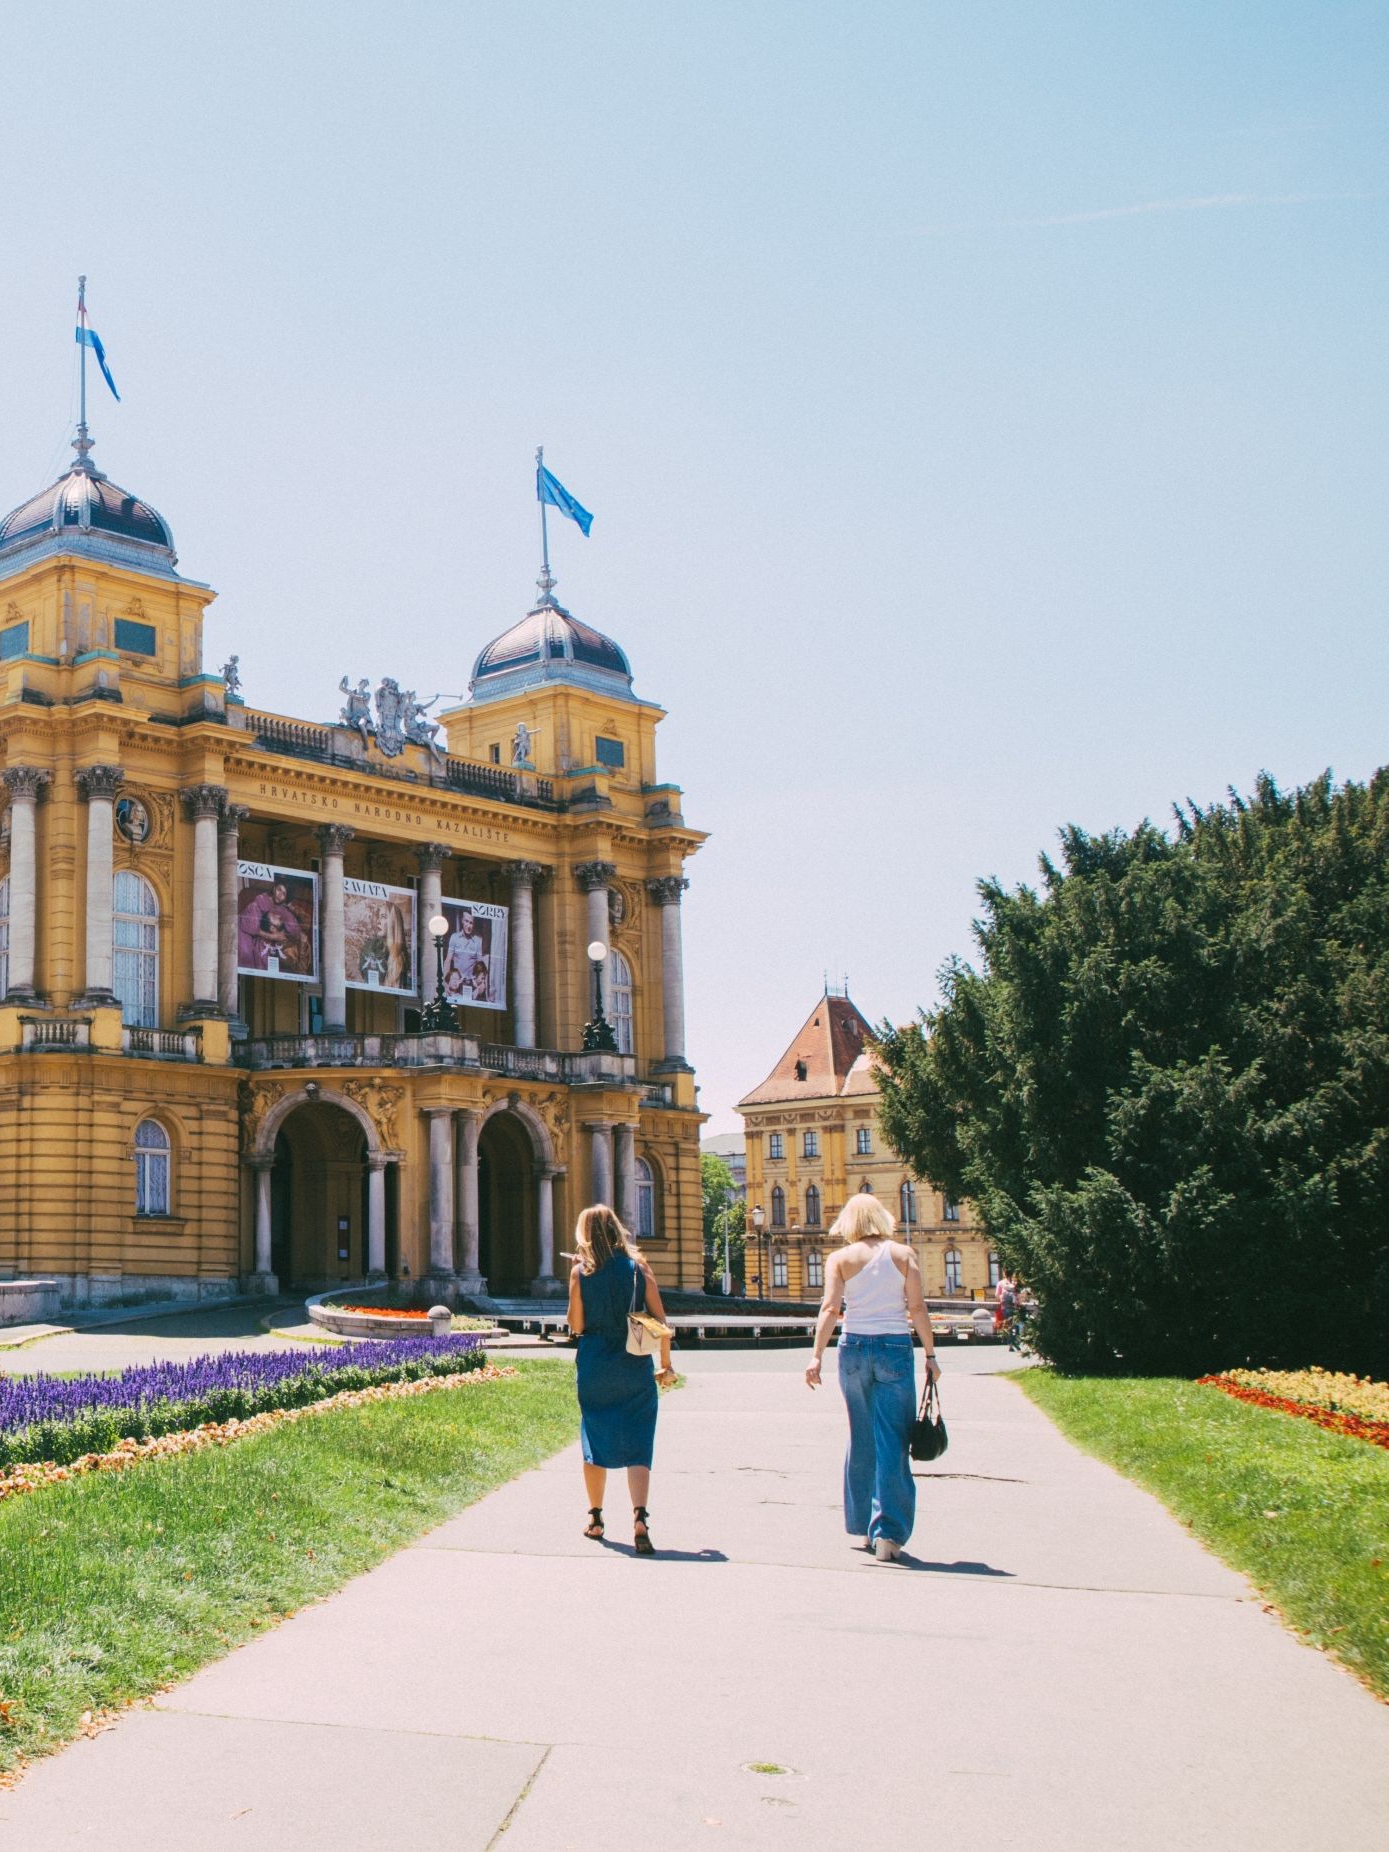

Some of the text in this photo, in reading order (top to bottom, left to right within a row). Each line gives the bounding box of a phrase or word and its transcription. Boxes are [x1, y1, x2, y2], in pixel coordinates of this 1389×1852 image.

[259, 783, 509, 843] HRVATSKO NARODNO KAZALIŠTE
[237, 862, 272, 879] OSCA
[472, 904, 505, 919] SORRY
